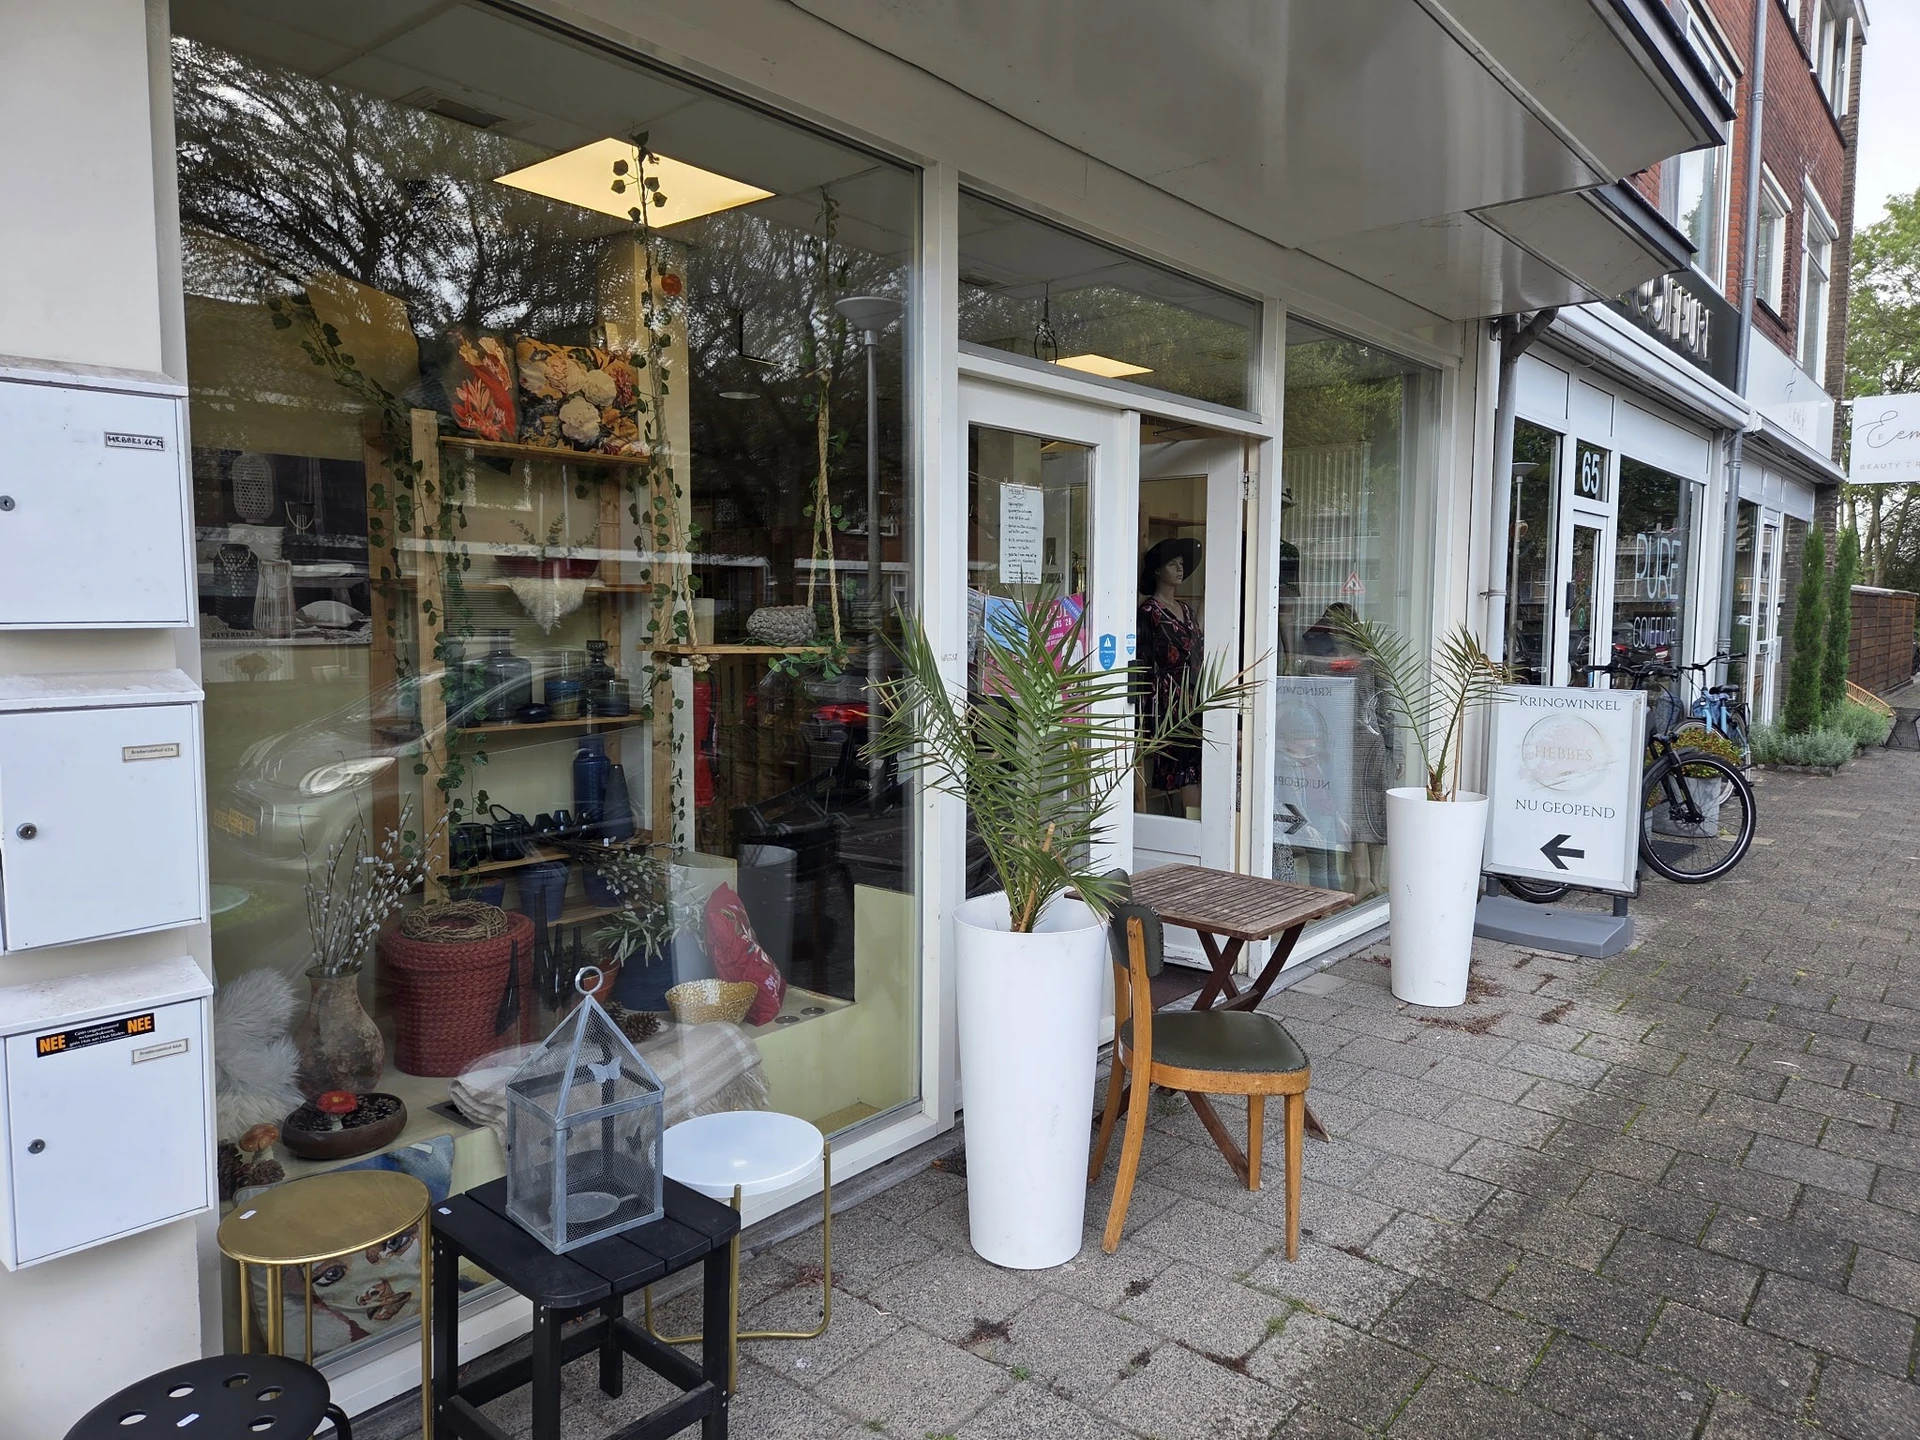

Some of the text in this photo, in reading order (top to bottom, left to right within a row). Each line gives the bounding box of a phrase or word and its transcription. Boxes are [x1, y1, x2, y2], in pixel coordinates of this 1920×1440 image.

[1582, 450, 1600, 494] 65
[1859, 462, 1900, 471] BEAUTY
[1633, 533, 1682, 600] PURE
[1632, 616, 1677, 648] COIFFURE
[1519, 695, 1621, 711] KRINGWINKEL
[1535, 745, 1593, 762] HEBBES
[1515, 798, 1616, 819] NU GEOPEND
[127, 1016, 152, 1034] NEE
[40, 1034, 67, 1053] NEE
